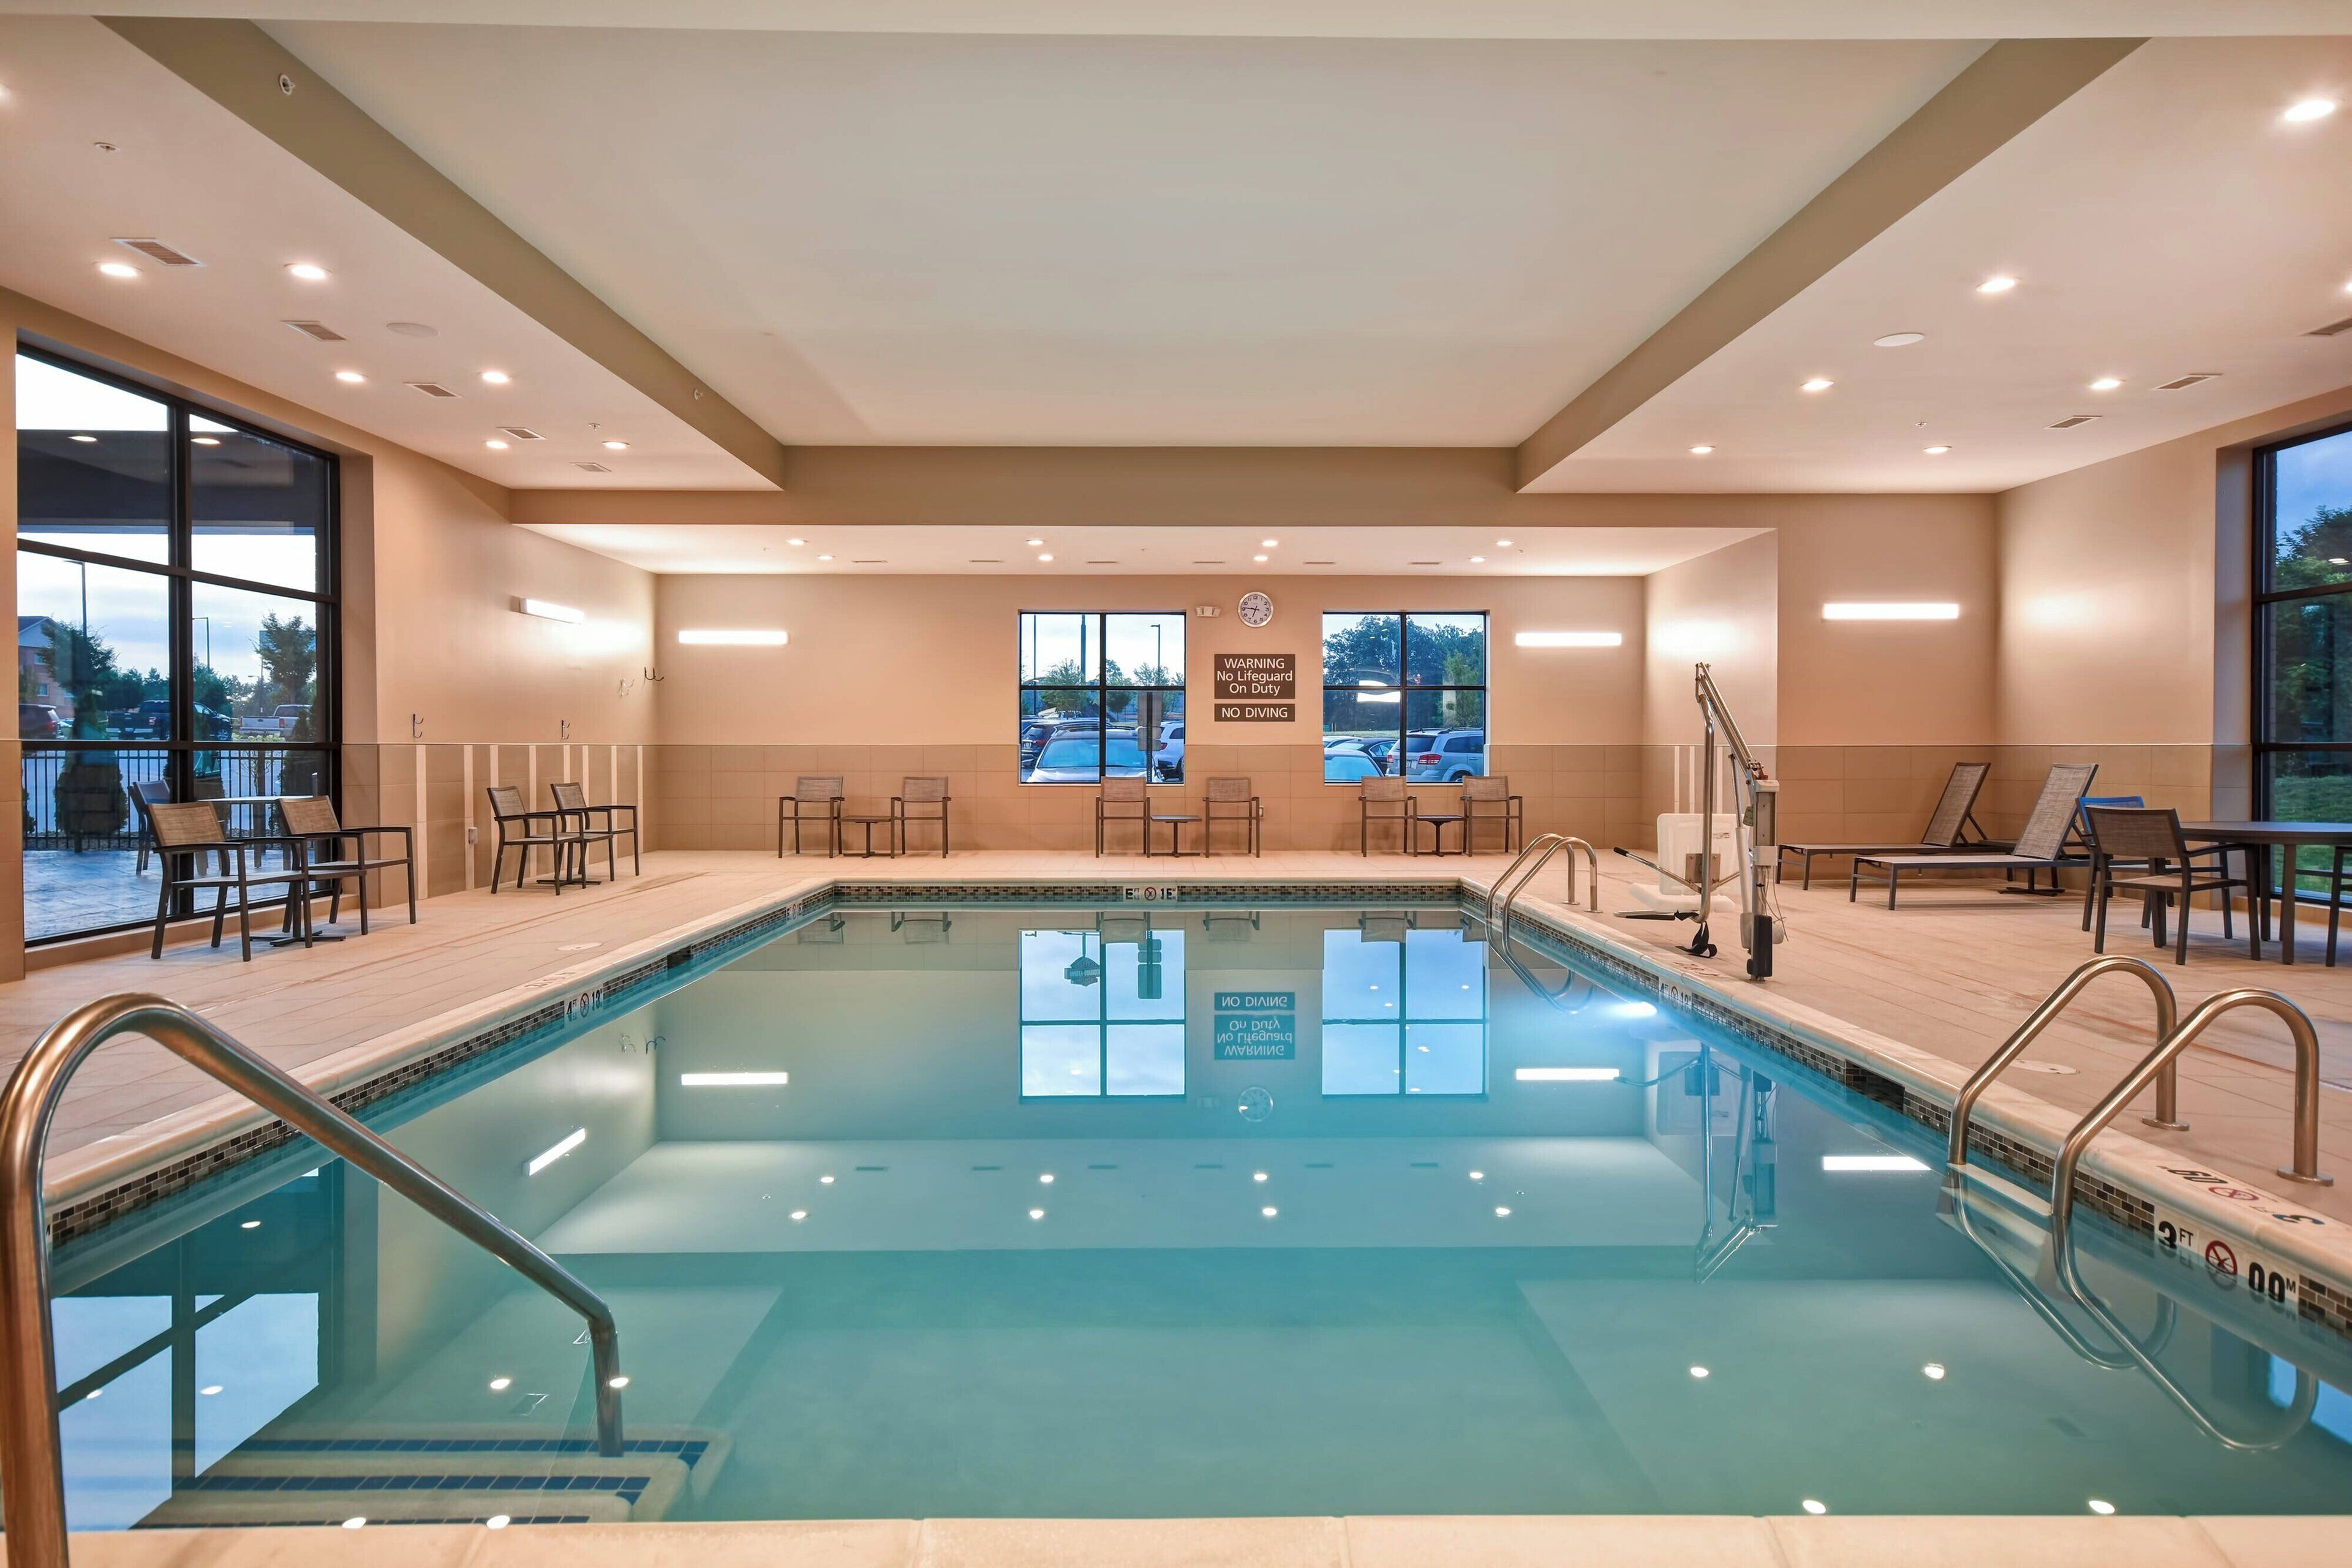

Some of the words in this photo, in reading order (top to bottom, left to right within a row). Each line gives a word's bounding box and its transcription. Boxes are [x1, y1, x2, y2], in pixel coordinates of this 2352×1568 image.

[1224, 658, 1285, 669] WARNING
[1217, 670, 1234, 681] No
[1238, 670, 1292, 684] Lifeguard
[1229, 683, 1246, 693] On
[1251, 683, 1280, 696] Duty
[1222, 707, 1240, 718] NO
[1245, 707, 1288, 718] DIVING
